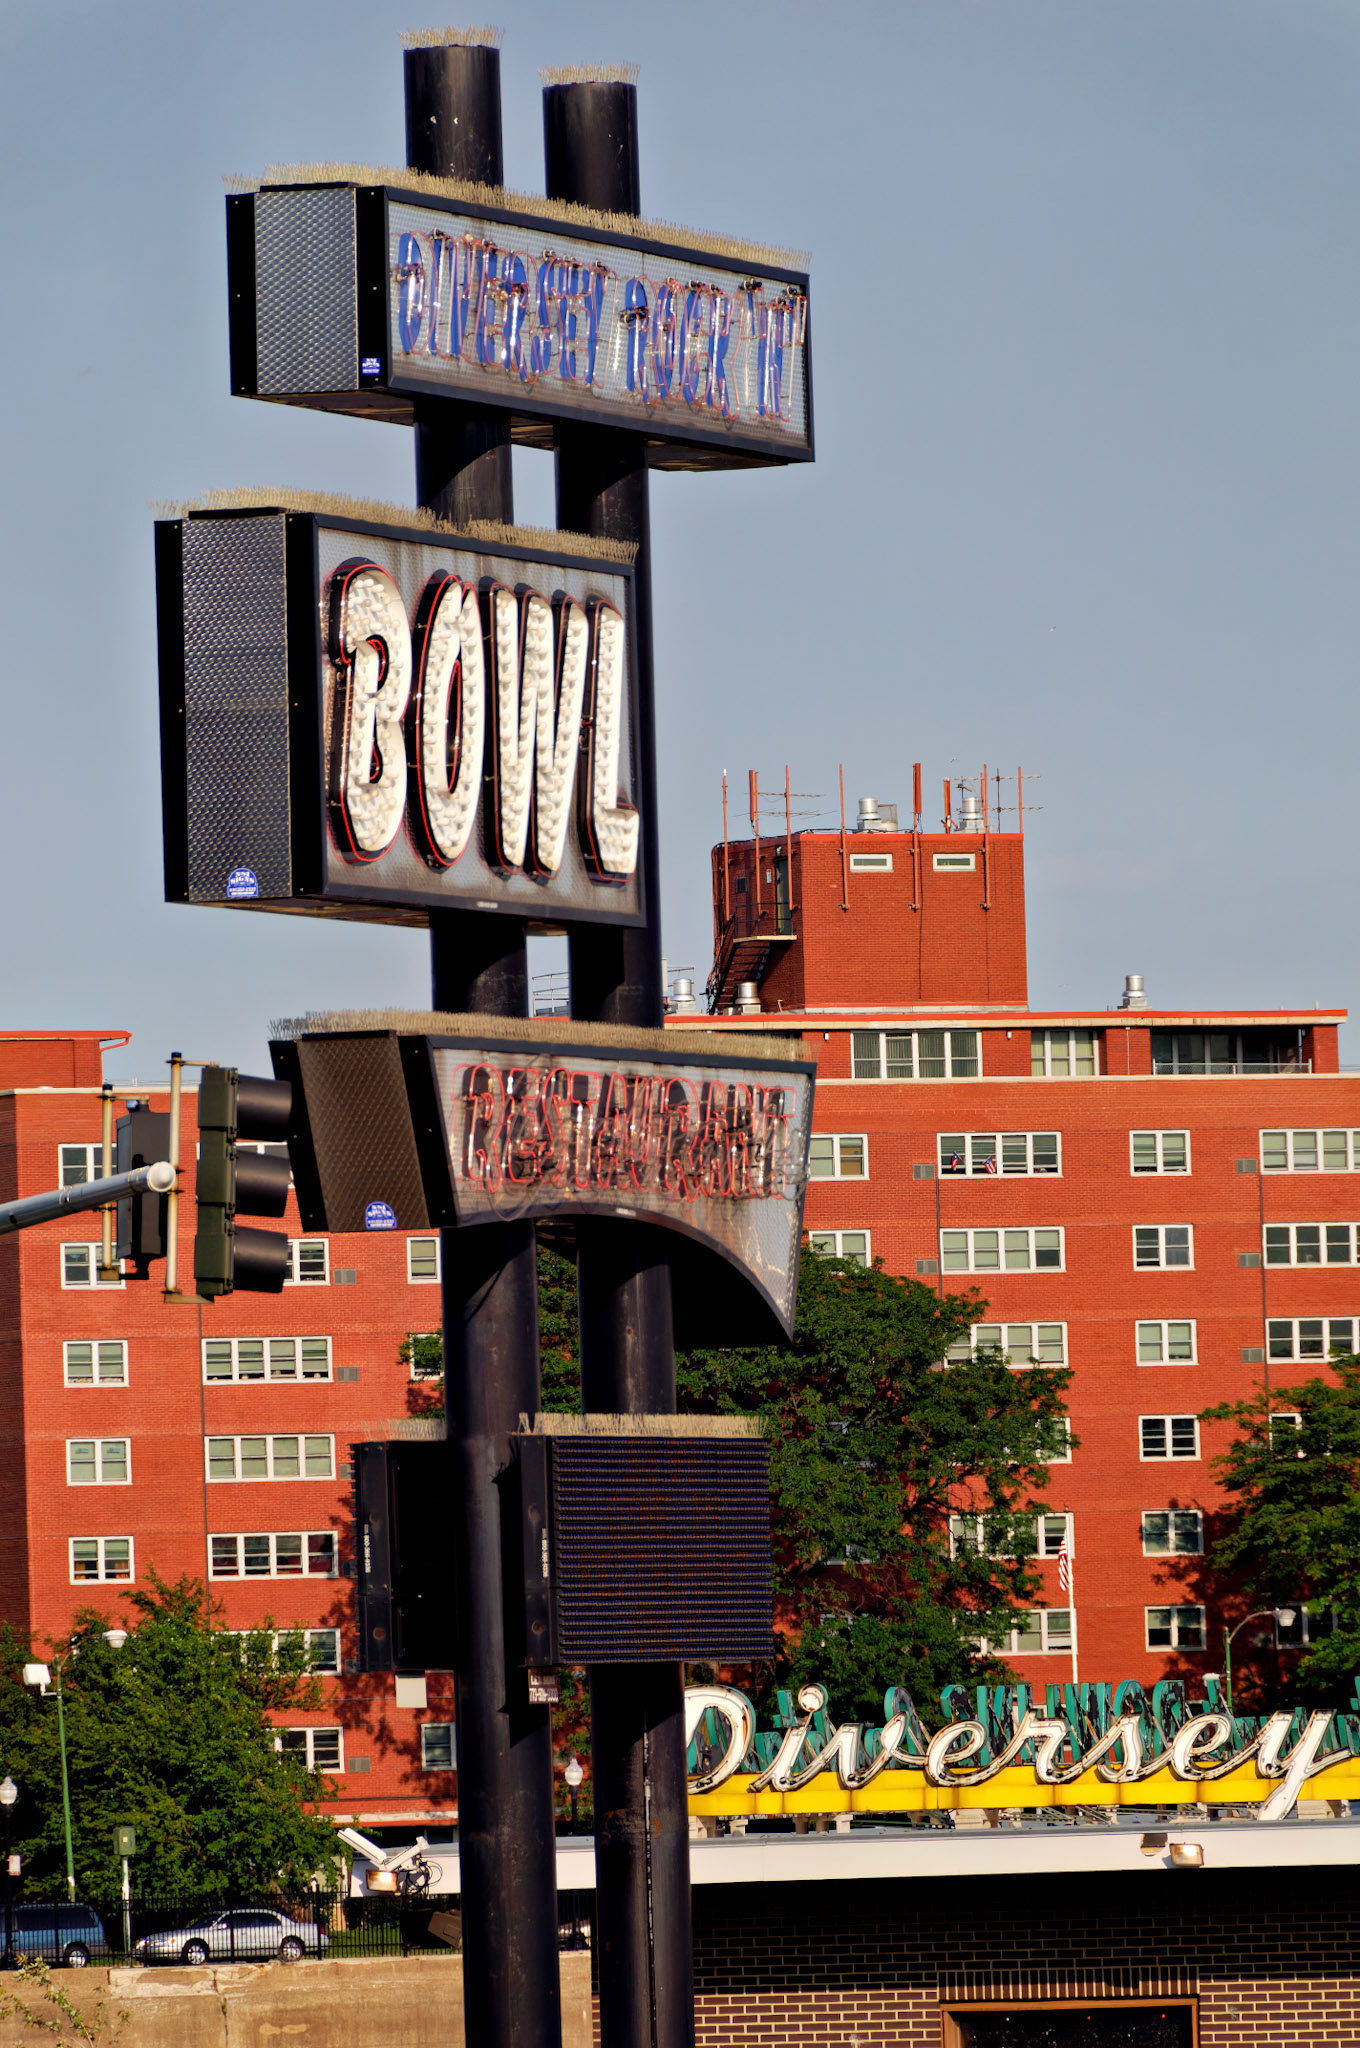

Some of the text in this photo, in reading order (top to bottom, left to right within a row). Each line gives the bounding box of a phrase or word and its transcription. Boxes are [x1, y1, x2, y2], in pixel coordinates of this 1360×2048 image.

[396, 230, 618, 390] DIVERSEY
[328, 559, 640, 884] BOWL
[457, 1063, 796, 1202] RESTAURANT
[685, 1682, 1352, 1821] Diversey
